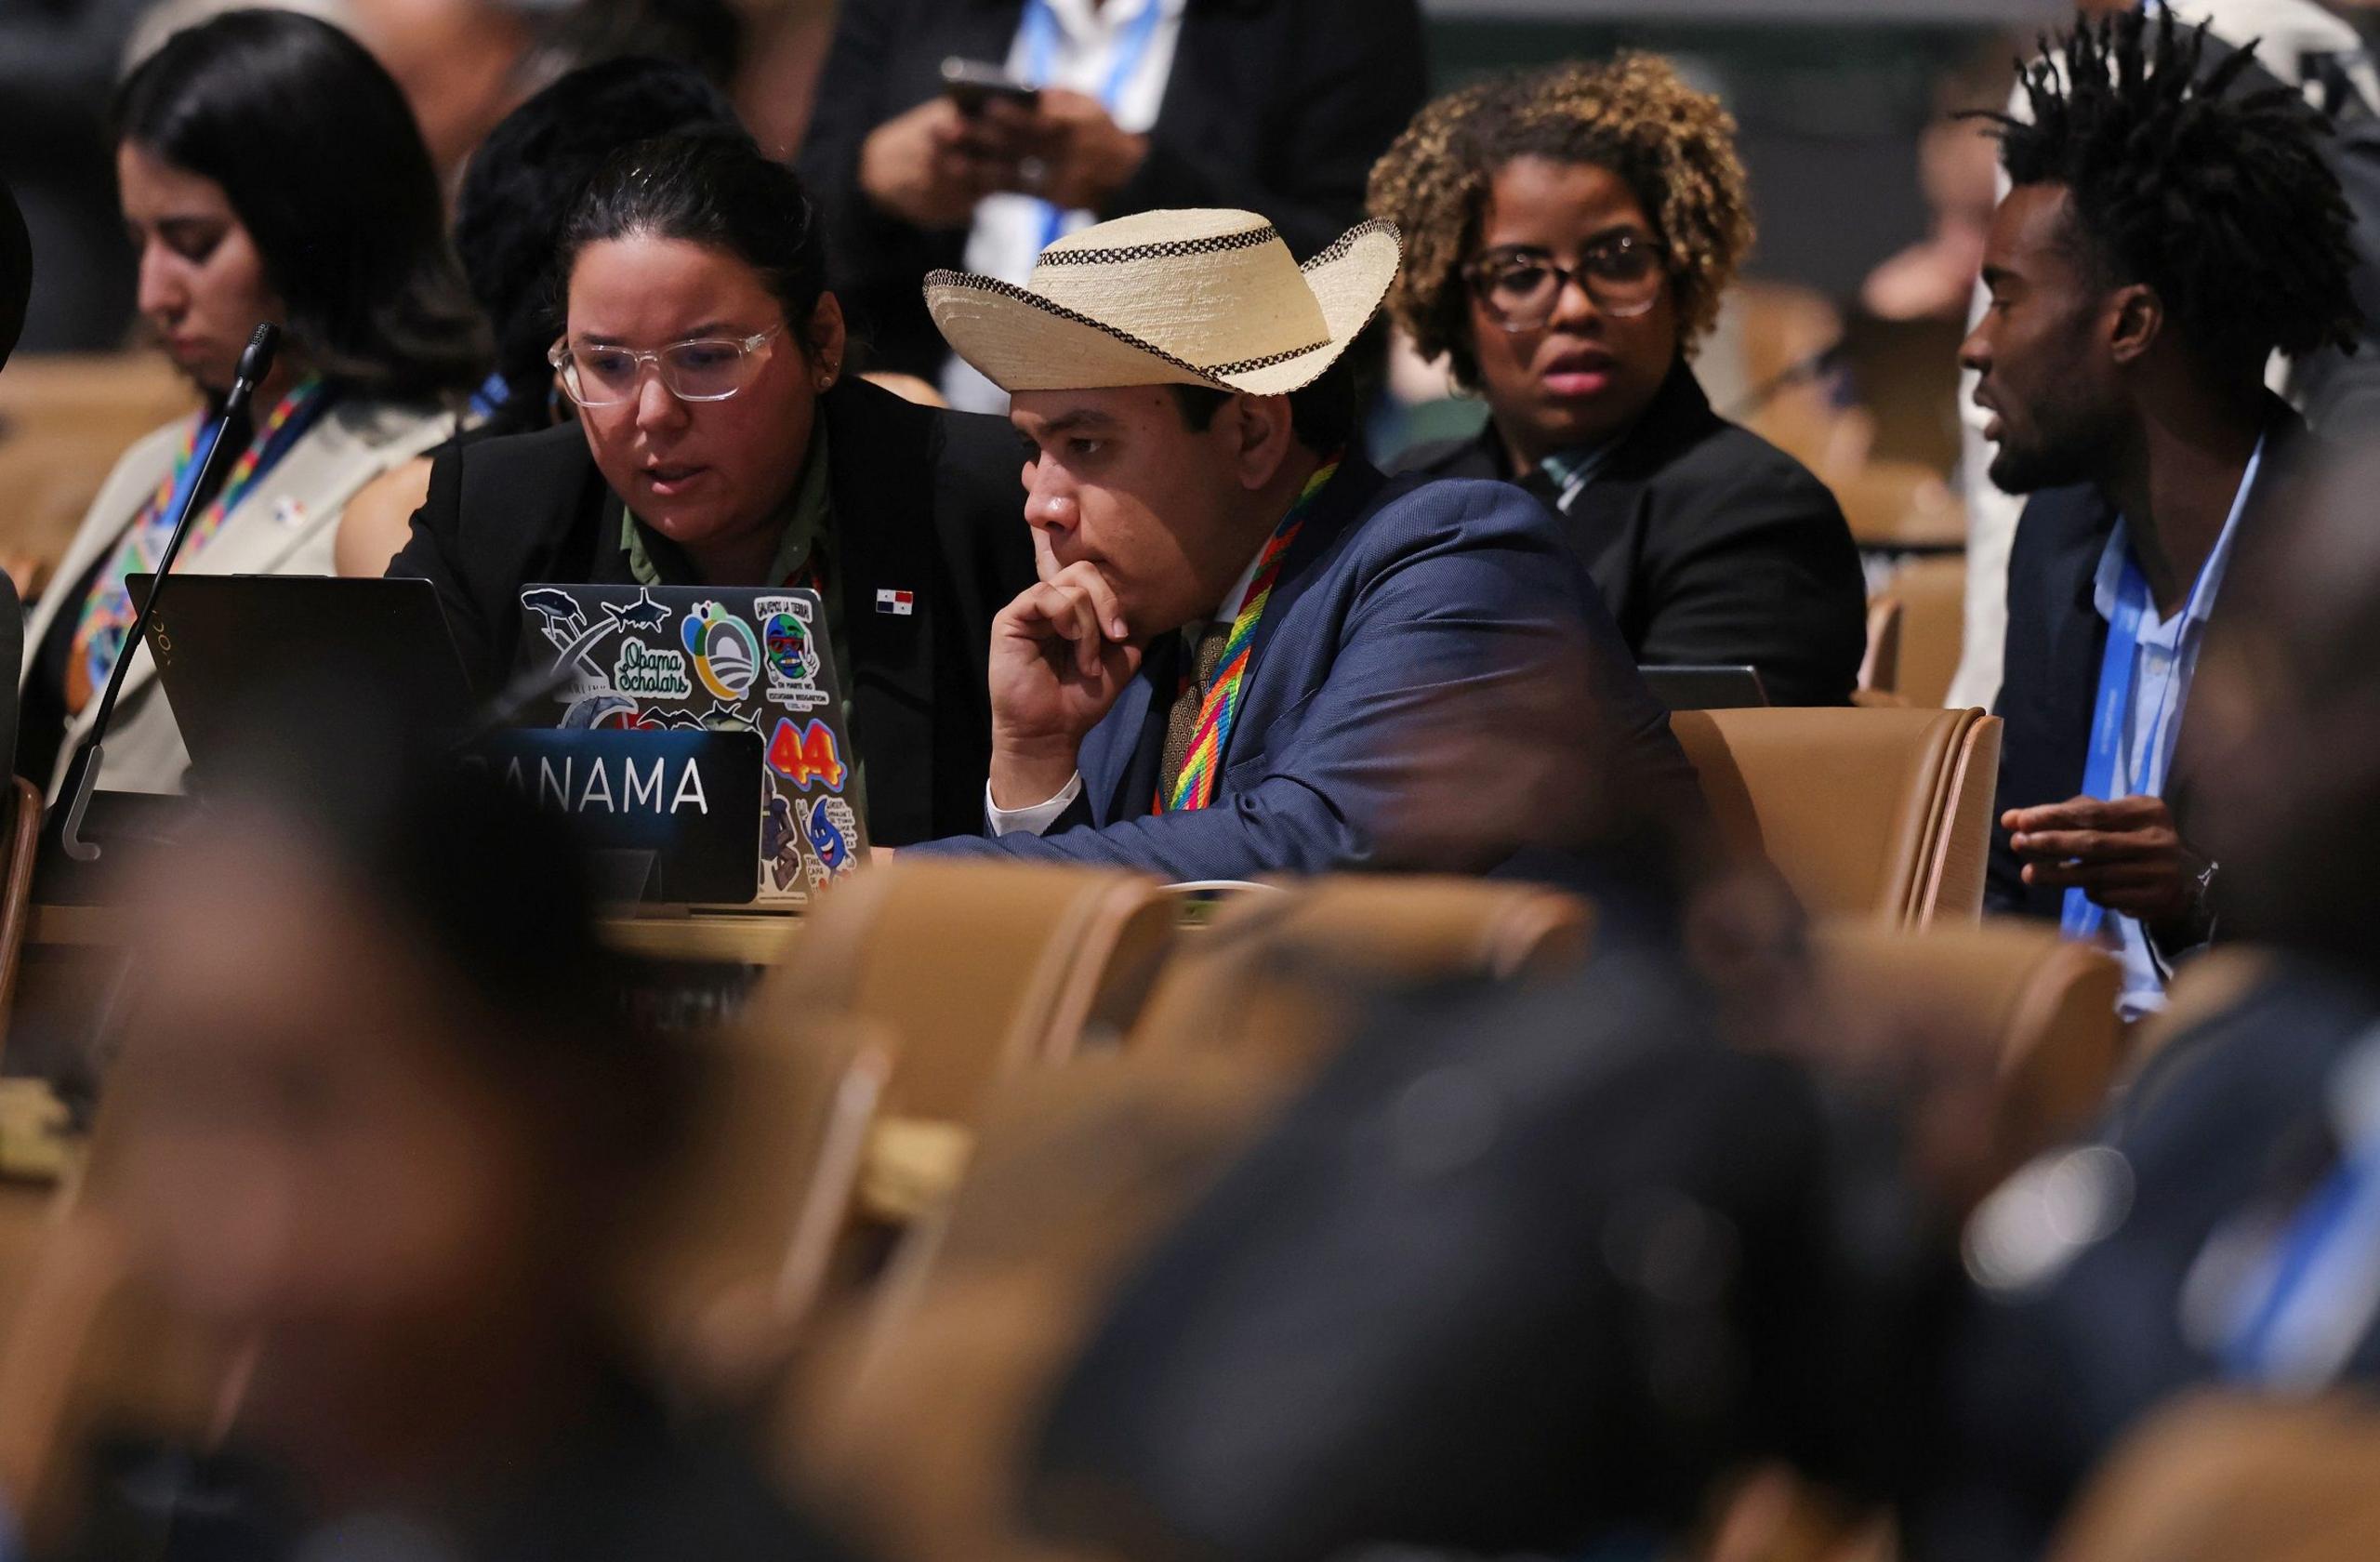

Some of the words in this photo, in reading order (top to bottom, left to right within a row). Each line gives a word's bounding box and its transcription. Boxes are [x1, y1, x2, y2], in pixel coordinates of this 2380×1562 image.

[625, 642, 682, 670] Obama
[618, 663, 689, 693] Scholars
[768, 718, 846, 790] 44
